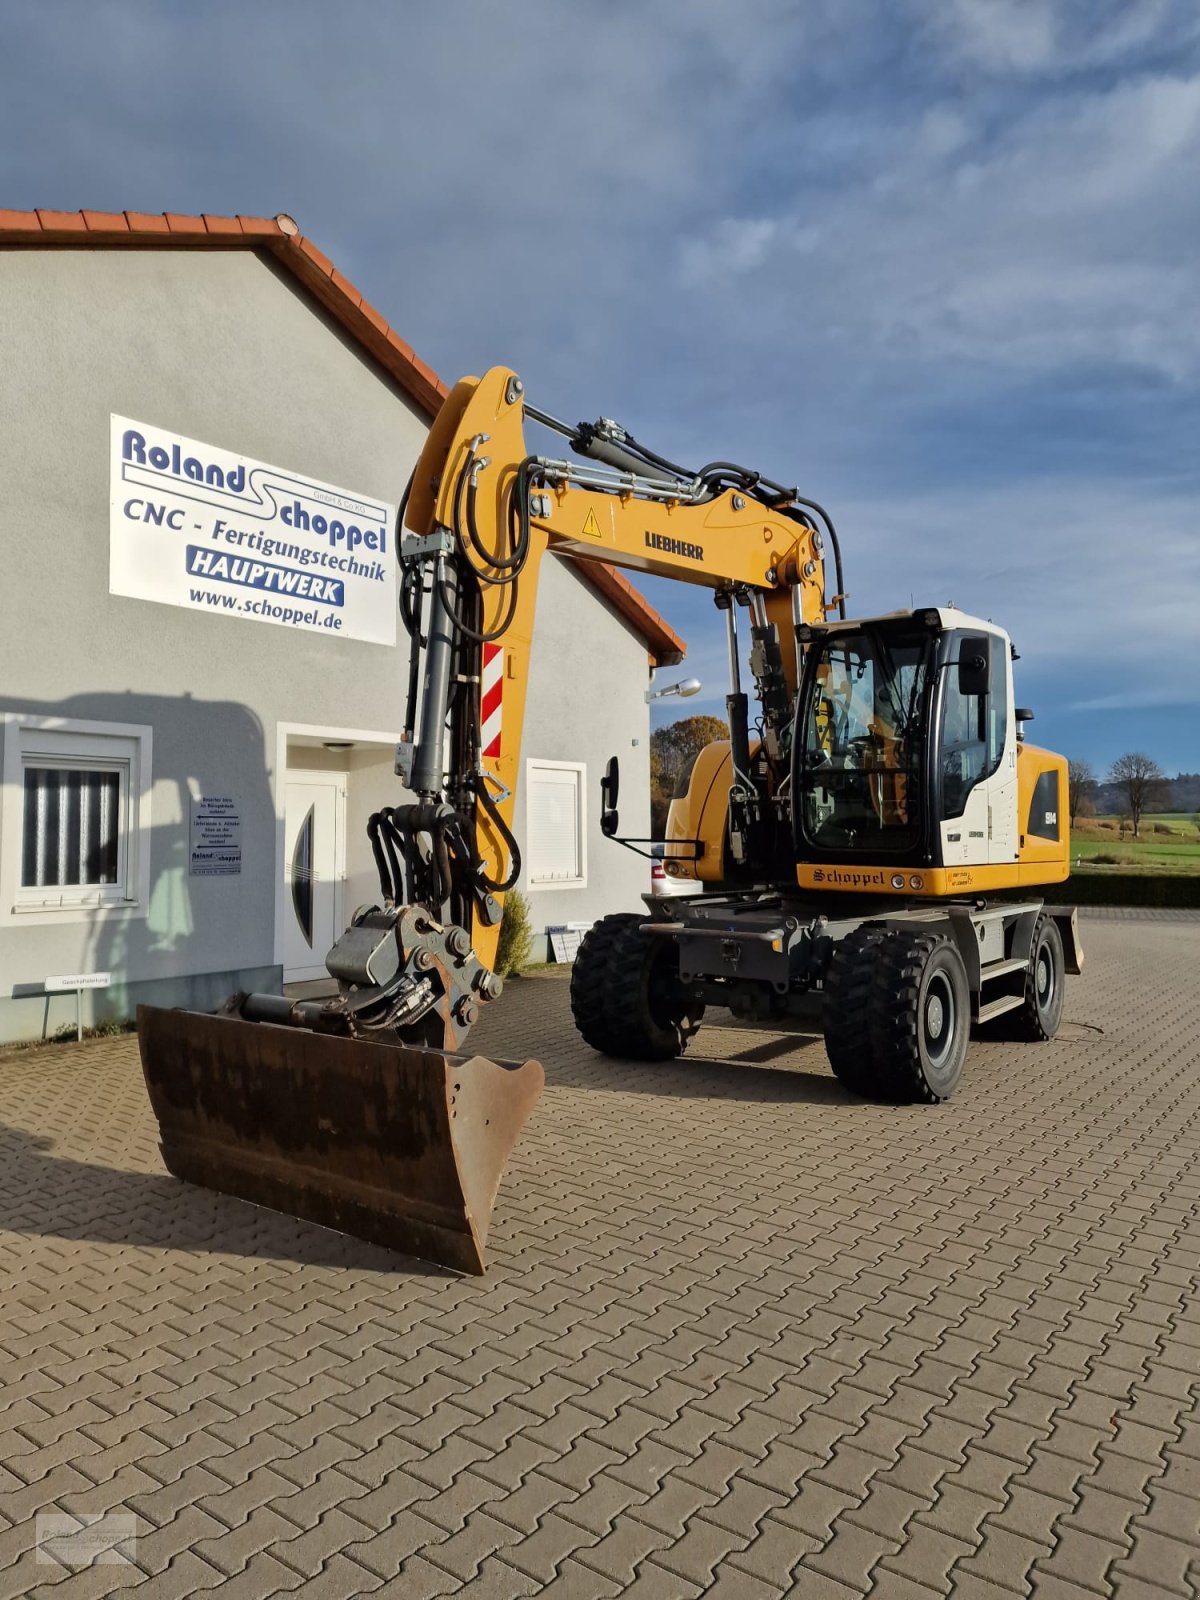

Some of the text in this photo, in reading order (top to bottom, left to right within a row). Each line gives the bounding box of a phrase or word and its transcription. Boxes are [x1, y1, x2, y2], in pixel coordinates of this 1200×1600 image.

[122, 430, 245, 493] Roland
[123, 498, 185, 530] CNC
[211, 519, 386, 582] Fertigungstechnik
[645, 530, 704, 561] LIEBHERR
[190, 550, 341, 603] HAUPTWERK
[189, 587, 343, 630] www.schoppel.de
[813, 869, 885, 887] Schoppel
